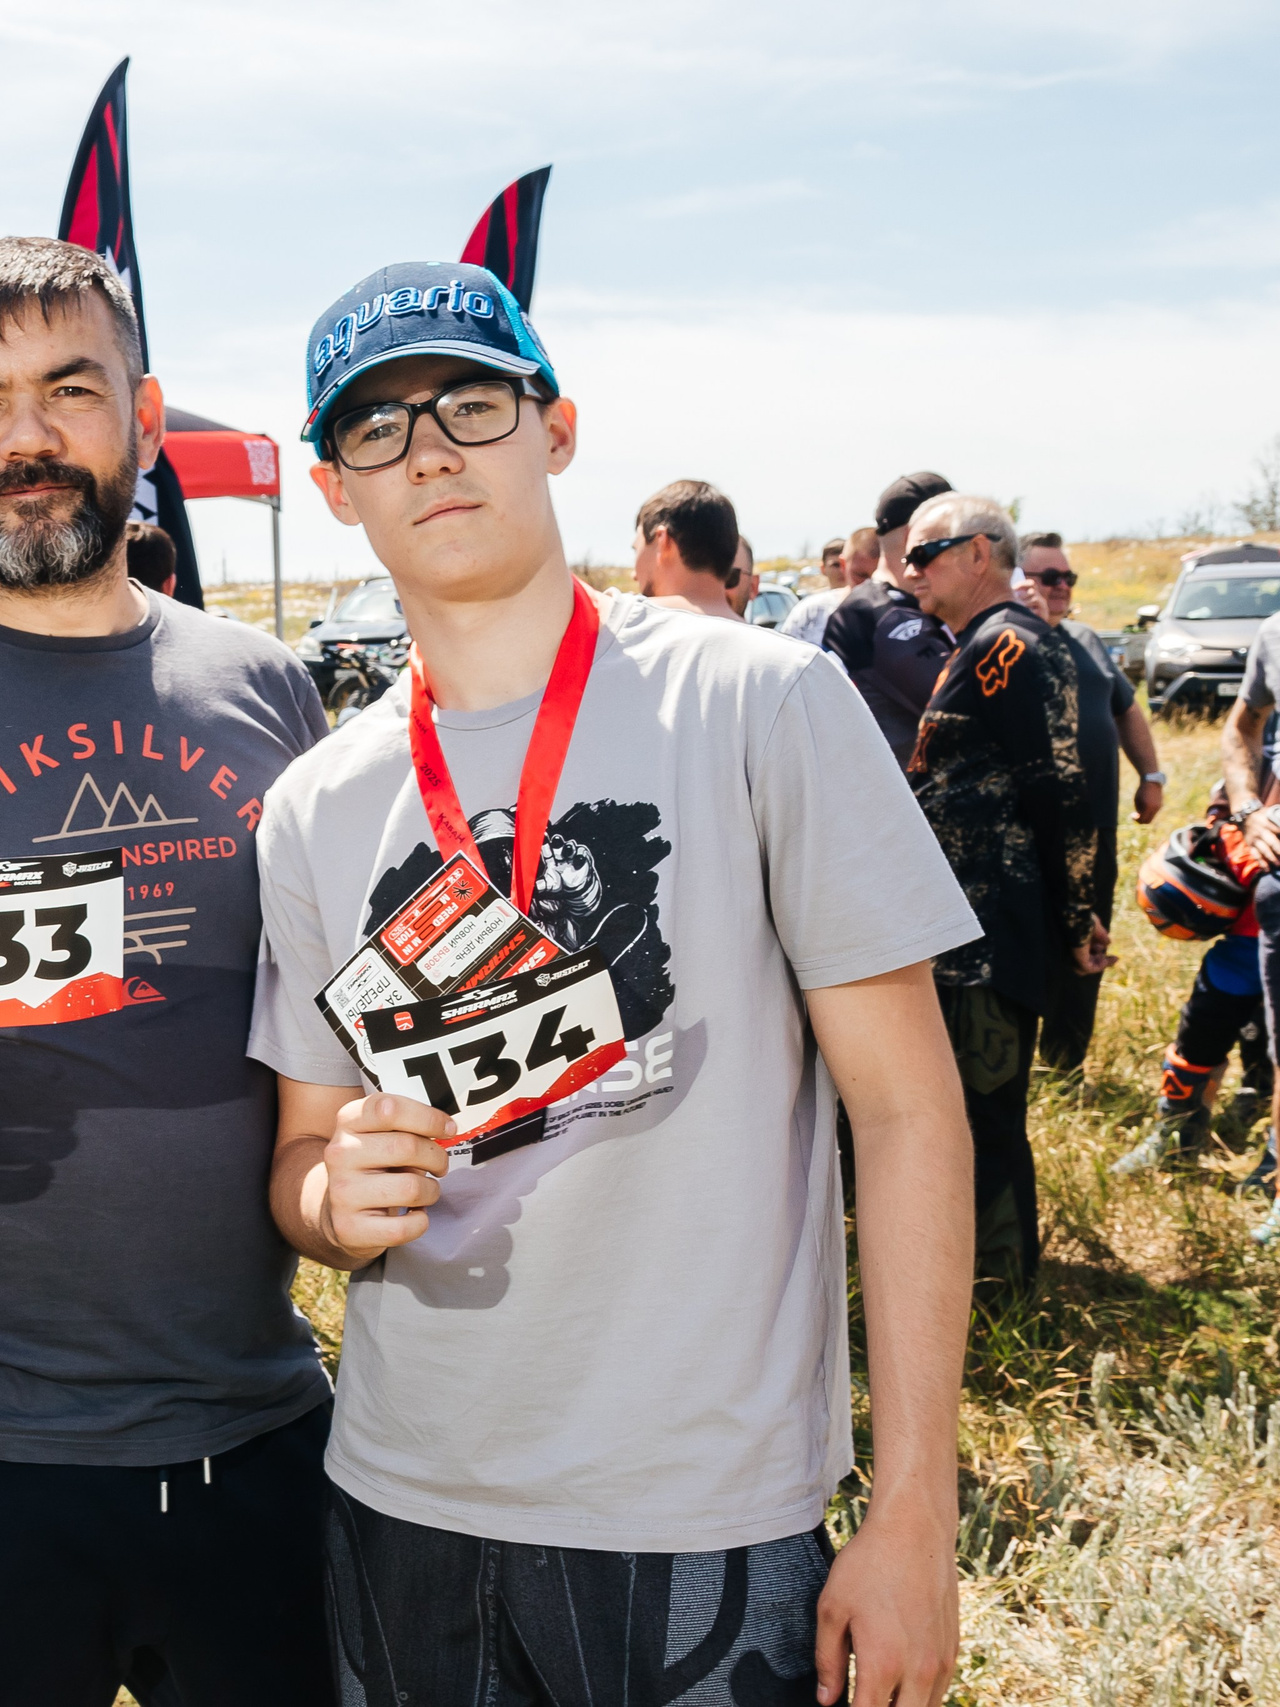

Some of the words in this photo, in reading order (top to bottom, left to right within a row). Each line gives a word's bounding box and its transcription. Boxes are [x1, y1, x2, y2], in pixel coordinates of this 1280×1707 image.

[313, 280, 495, 376] aquario
[420, 762, 441, 787] 2025
[122, 836, 238, 868] NSPIRED
[127, 882, 175, 901] 1969
[448, 920, 477, 949] НОВЫЙ
[475, 916, 504, 945] НОВЫЙ
[423, 944, 451, 971] ВЫЗОВ
[455, 941, 476, 961] ДЕНЬ
[345, 975, 391, 1023] ПРЕДЕЛЫ
[384, 989, 403, 1006] ЗА
[440, 990, 518, 1020] SHARMAX
[402, 1004, 596, 1116] 134
[453, 1146, 473, 1157] QUEST
